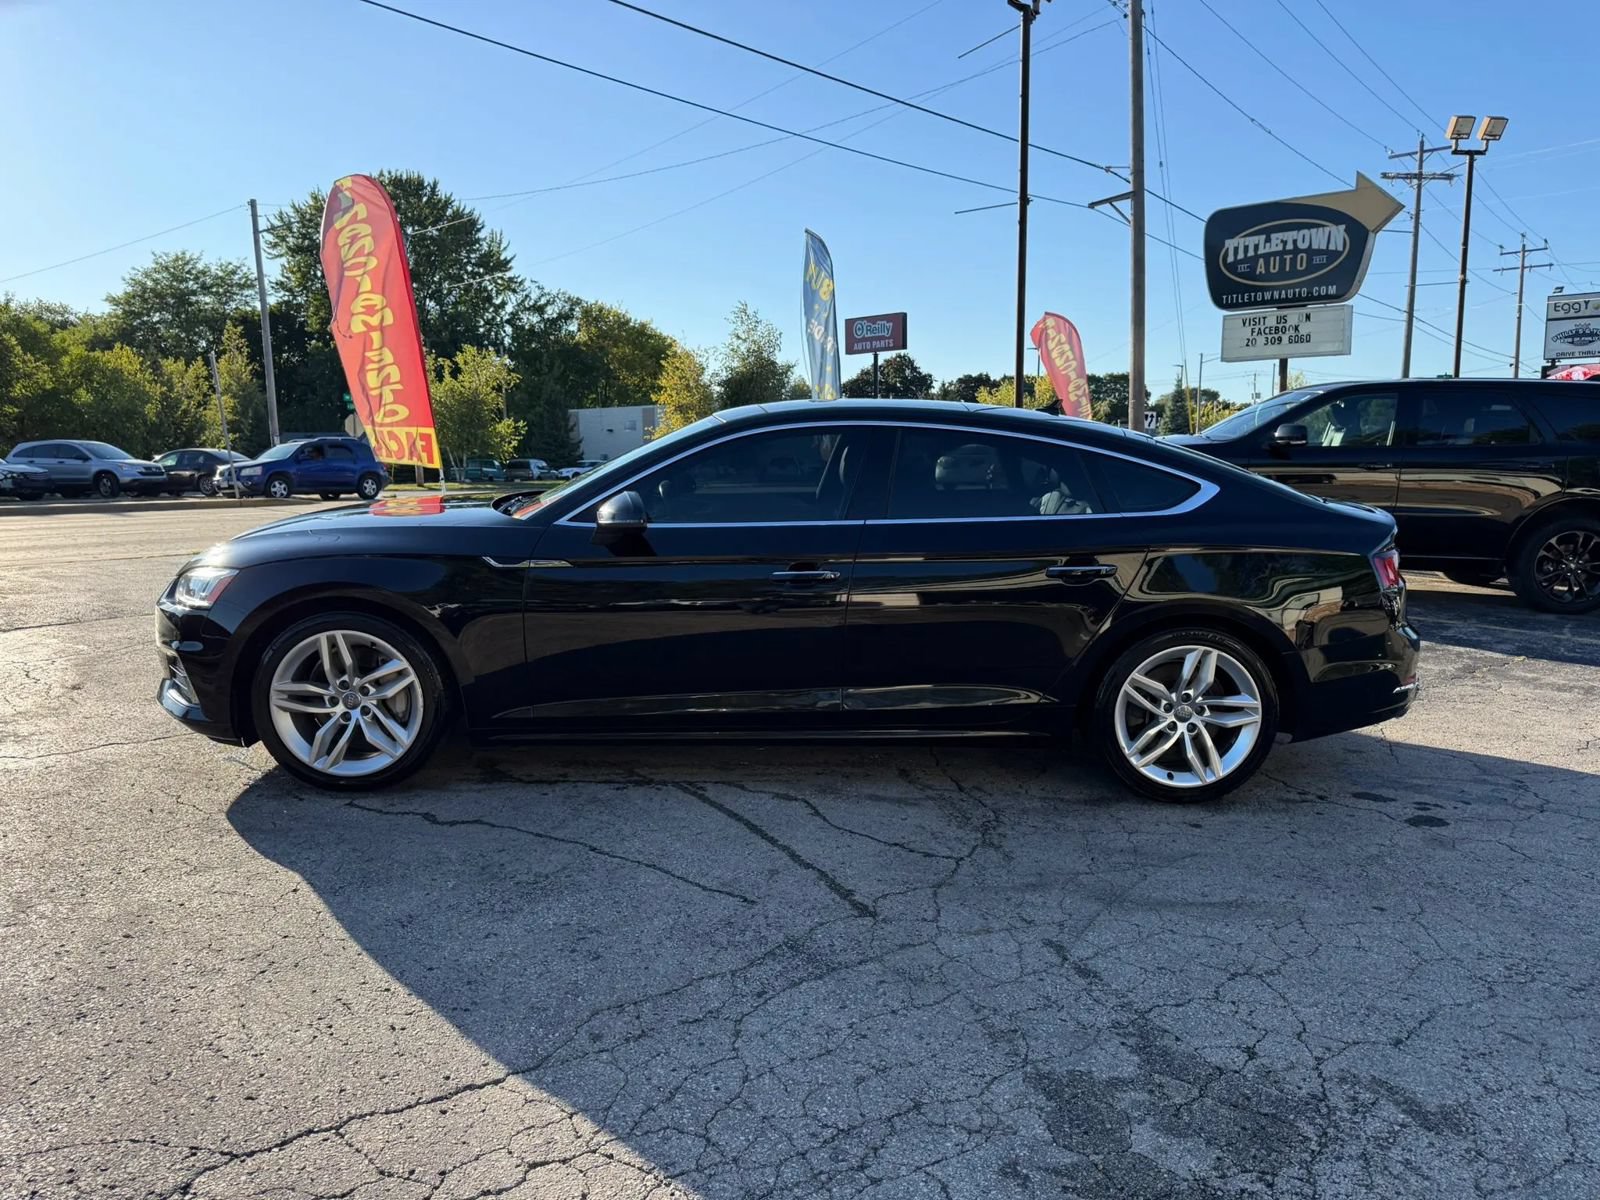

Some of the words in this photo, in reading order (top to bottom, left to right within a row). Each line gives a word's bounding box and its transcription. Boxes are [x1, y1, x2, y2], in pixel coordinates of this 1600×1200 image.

[1224, 224, 1346, 264] TITLETOWN
[1256, 253, 1307, 275] AUTO
[1222, 285, 1337, 304] TITLETOWNAUTO.COM
[1242, 316, 1267, 327] VISIT
[1276, 315, 1288, 325] US
[853, 321, 892, 338] O'Reilly
[1251, 324, 1300, 336] FACEBOOK
[853, 340, 870, 350] AUTO
[872, 339, 894, 348] PARTS
[1263, 336, 1282, 346] 309
[1288, 333, 1311, 344] 6060
